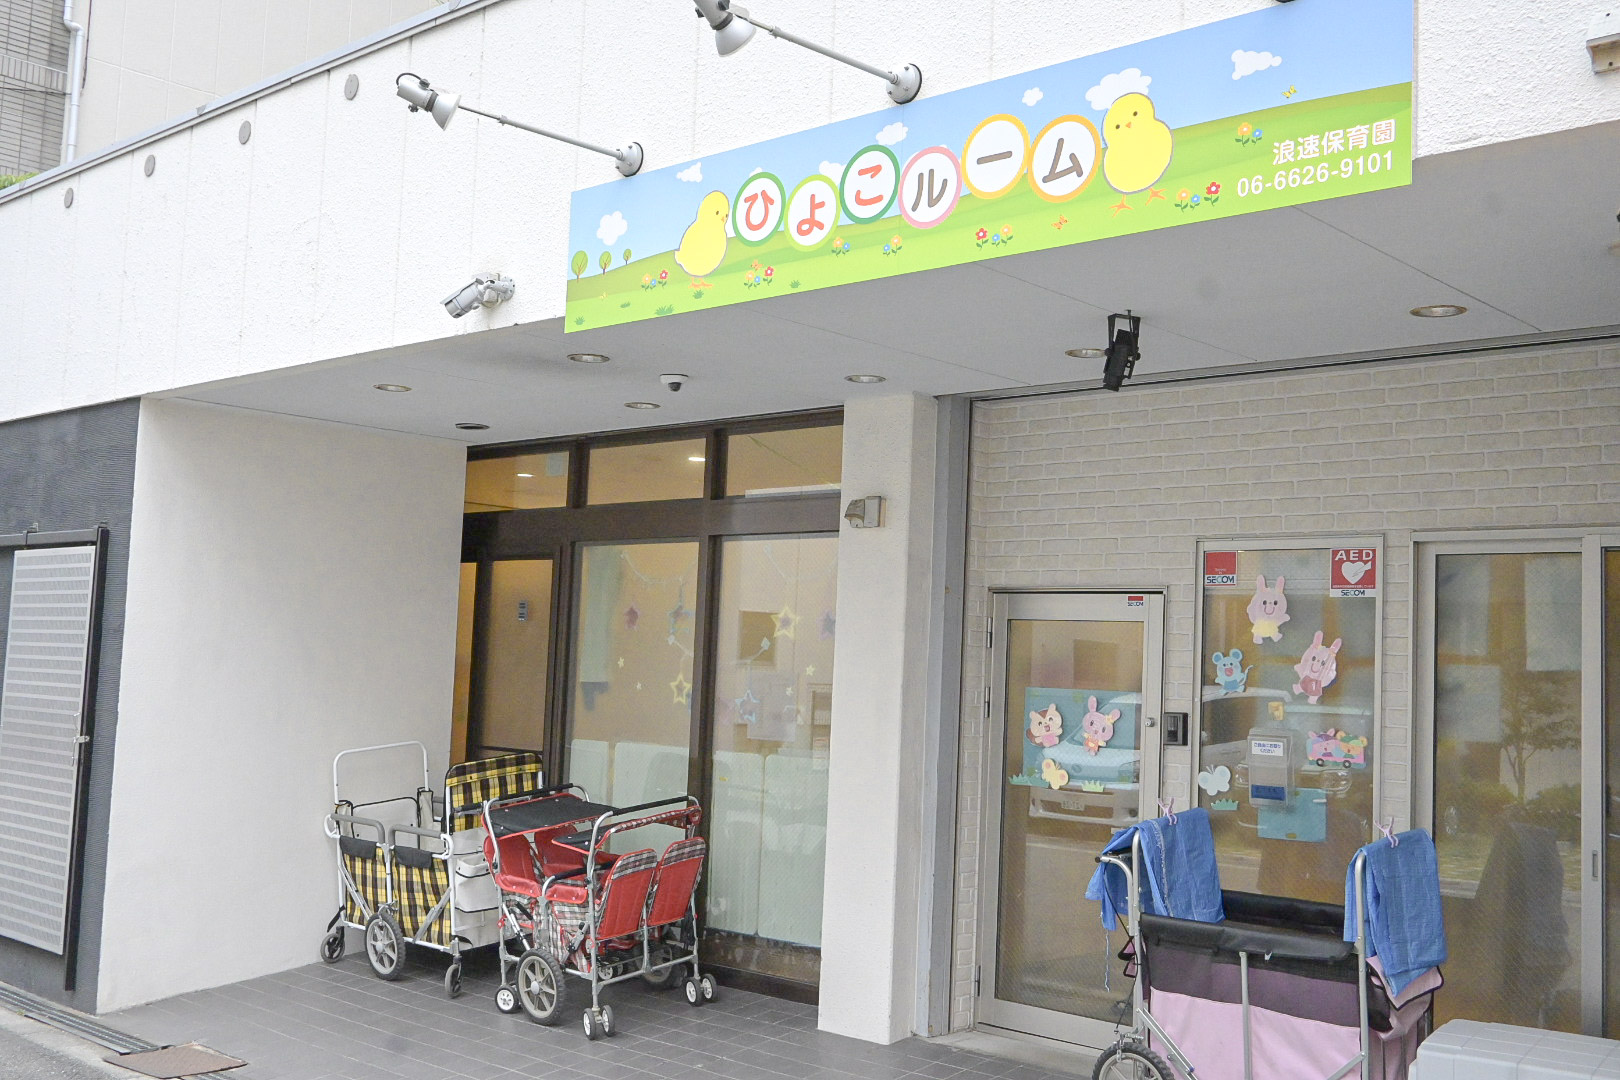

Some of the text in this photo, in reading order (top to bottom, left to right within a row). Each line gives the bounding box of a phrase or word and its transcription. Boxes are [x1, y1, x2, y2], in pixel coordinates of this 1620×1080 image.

[1272, 119, 1396, 165] 浪速保育園
[743, 137, 1085, 237] ひよこルーム
[1237, 150, 1393, 197] 06-6626-9101
[1334, 549, 1374, 561] AED
[1206, 575, 1235, 584] SECOM
[1340, 589, 1366, 597] SECOM
